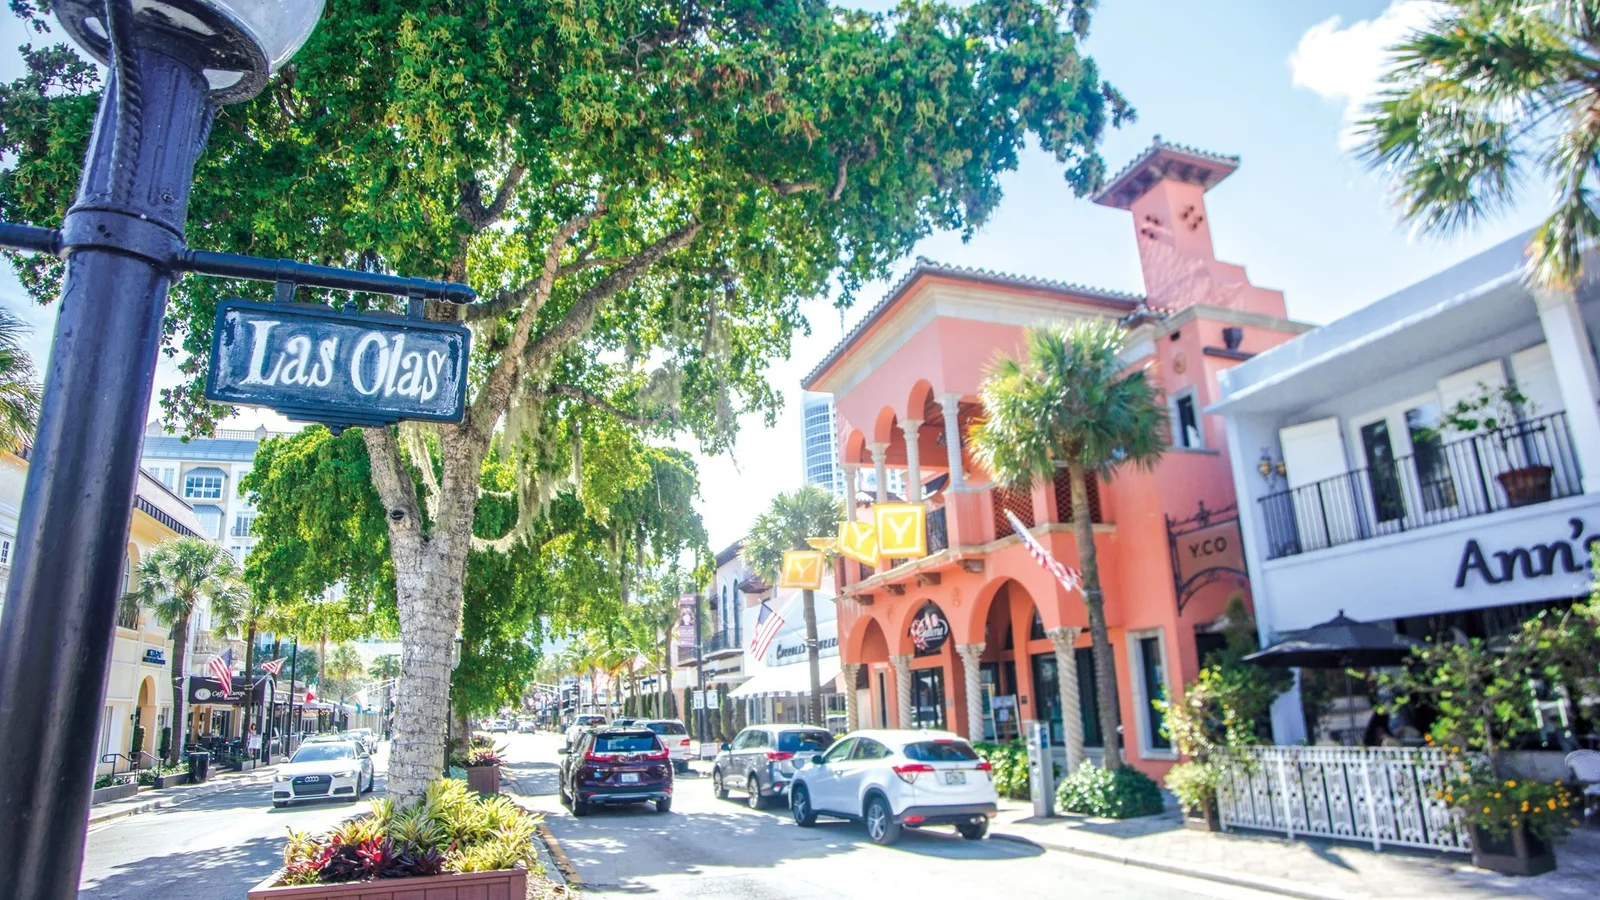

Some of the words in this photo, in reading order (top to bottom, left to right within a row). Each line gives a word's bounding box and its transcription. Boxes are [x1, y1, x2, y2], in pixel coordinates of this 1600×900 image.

[239, 320, 338, 387] Las
[351, 330, 447, 404] Olas
[852, 523, 874, 549] Y
[887, 516, 913, 544] Y
[794, 560, 814, 580] Y
[212, 689, 225, 699] Caff
